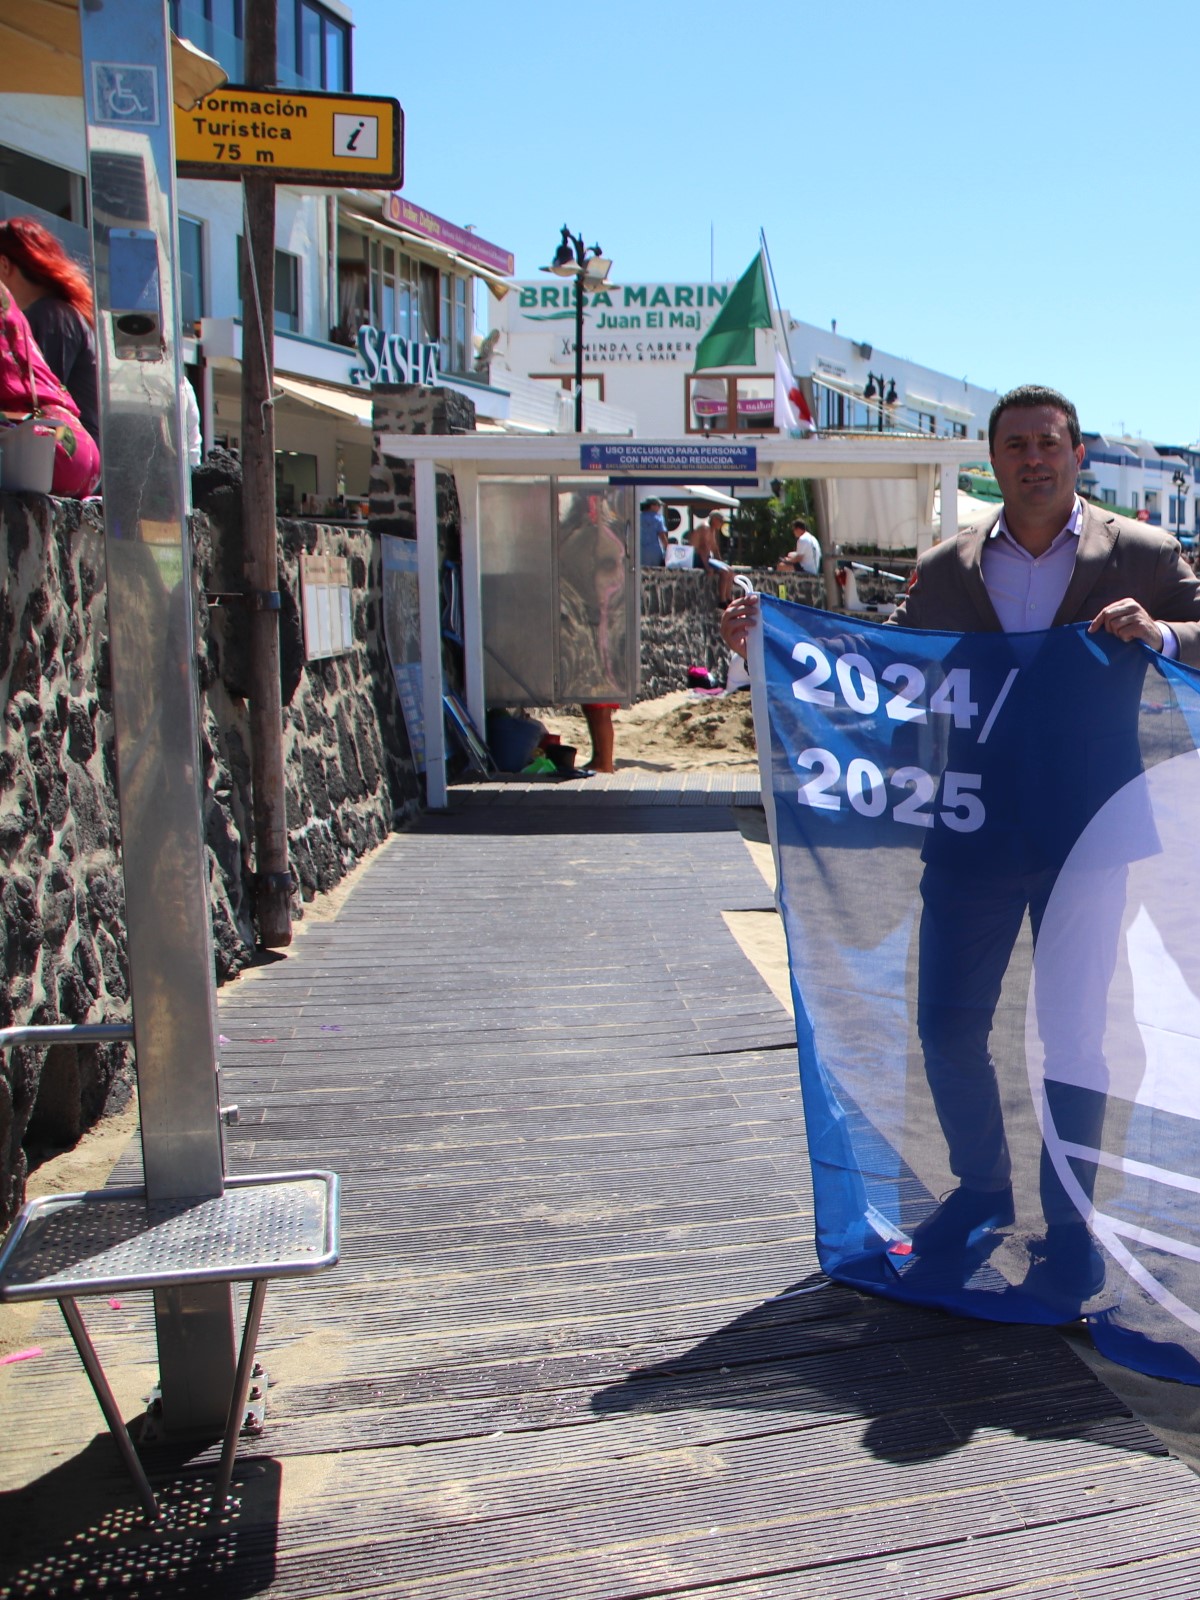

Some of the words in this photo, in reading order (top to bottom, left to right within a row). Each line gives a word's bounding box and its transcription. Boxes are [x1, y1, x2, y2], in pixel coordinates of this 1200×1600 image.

[193, 117, 292, 140] Turística
[213, 143, 242, 161] 75
[256, 150, 275, 163] m
[624, 286, 728, 307] MARIN
[596, 312, 641, 329] Juan
[646, 312, 663, 328] El
[669, 312, 701, 331] Maj
[350, 324, 439, 386] SASHA
[584, 352, 632, 361] BEAUTY
[650, 352, 677, 361] HAIR
[636, 342, 695, 352] CABRER
[605, 446, 624, 454] USO
[626, 446, 674, 455] EXCLUSIVO
[676, 447, 699, 455] PARA
[701, 447, 748, 456] PERSONAS
[640, 456, 688, 464] MOVILIDAD
[690, 456, 734, 464] REDUCIDA
[792, 642, 1019, 744] 2024/
[797, 747, 986, 833] 2025
